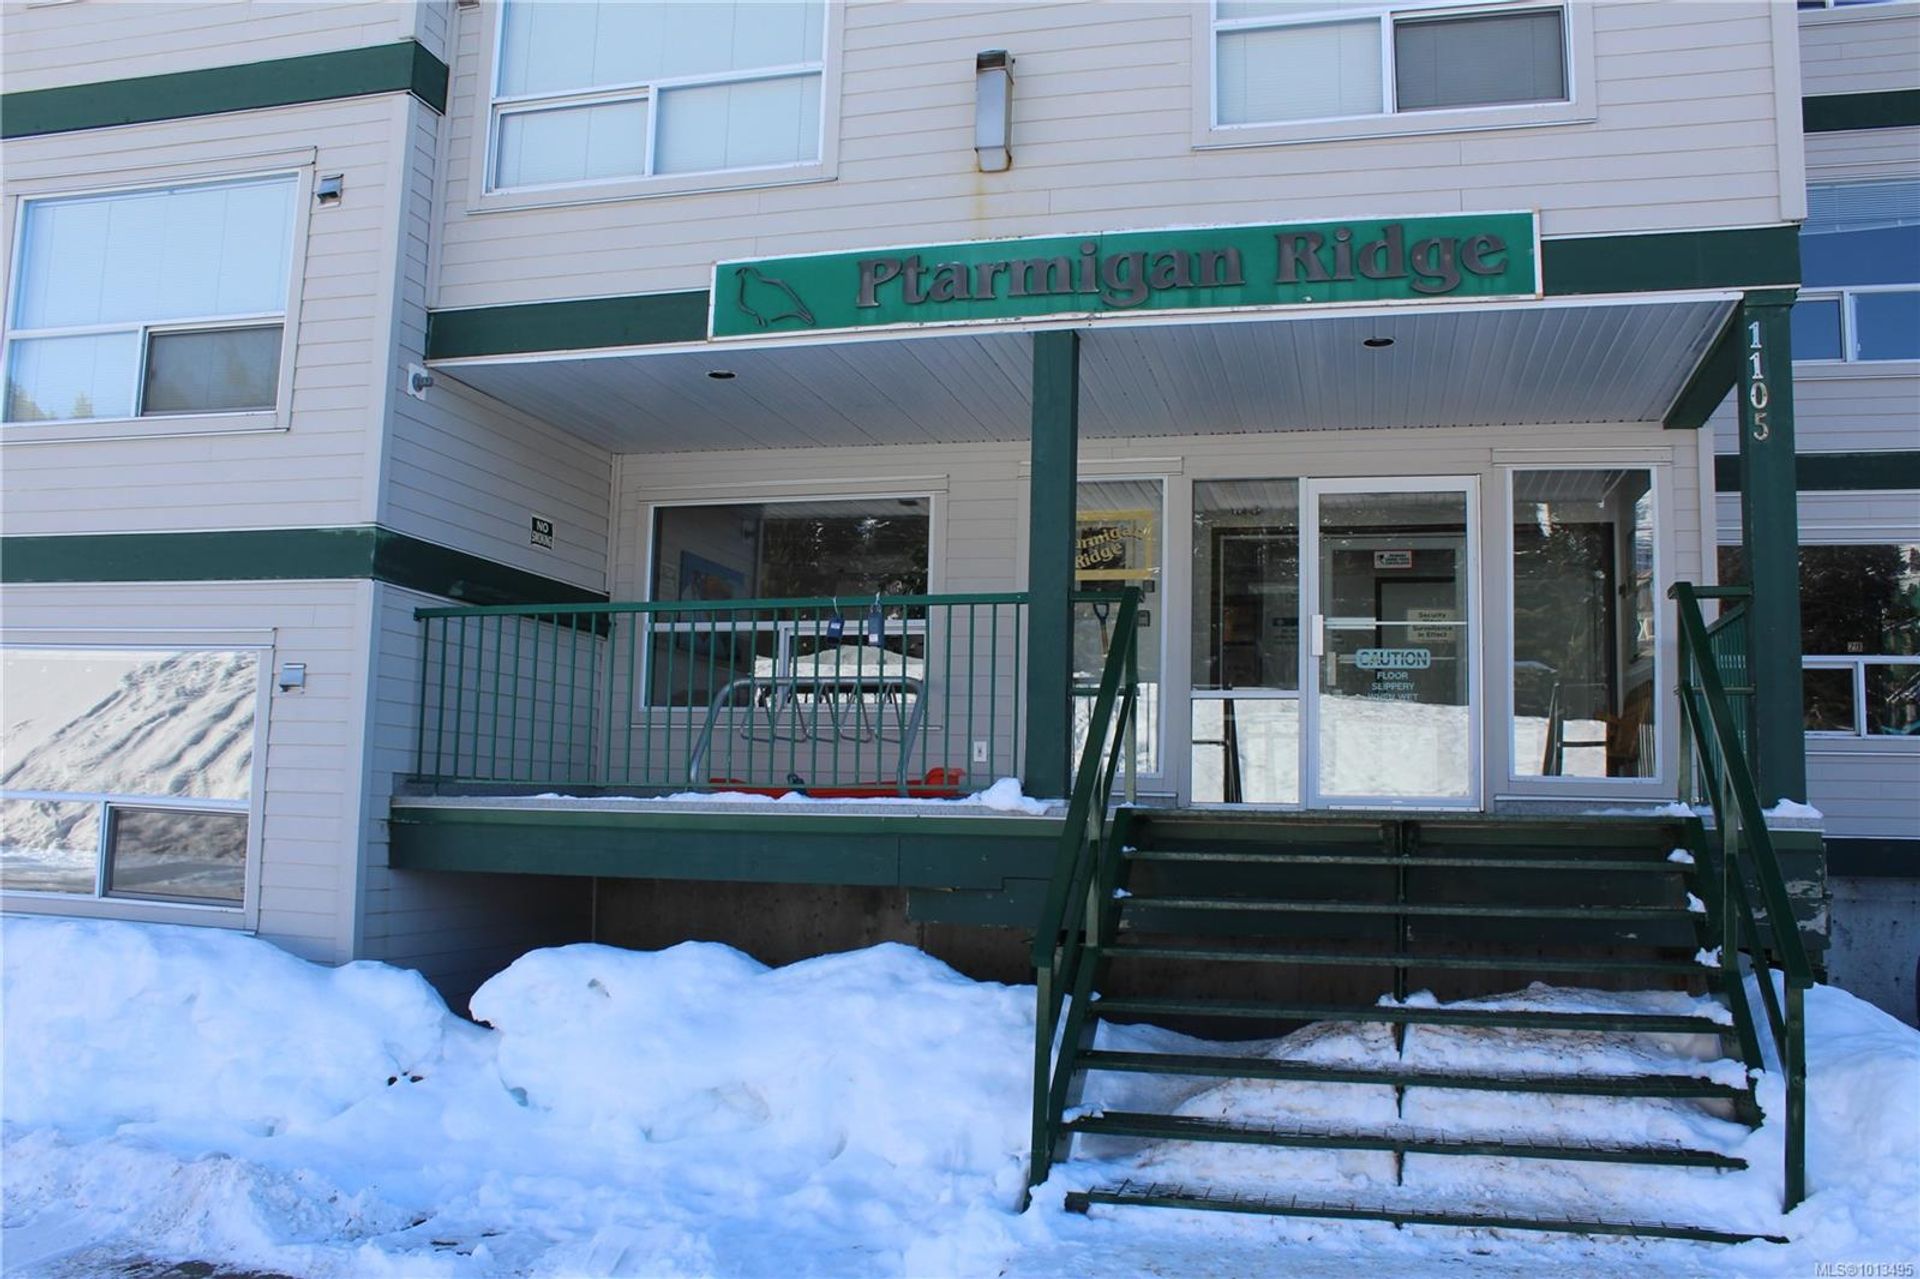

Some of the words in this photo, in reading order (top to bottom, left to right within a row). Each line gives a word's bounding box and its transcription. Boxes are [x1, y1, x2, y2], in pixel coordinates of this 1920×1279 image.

[855, 240, 1246, 308] Ptarmigan
[1274, 222, 1509, 295] Ridge
[1748, 320, 1769, 441] 1105
[536, 520, 550, 533] NO
[1075, 543, 1123, 569] Ridge
[1360, 651, 1428, 667] CAUTION
[1376, 671, 1409, 680] FLOOR
[1371, 682, 1416, 691] SLIPPERY
